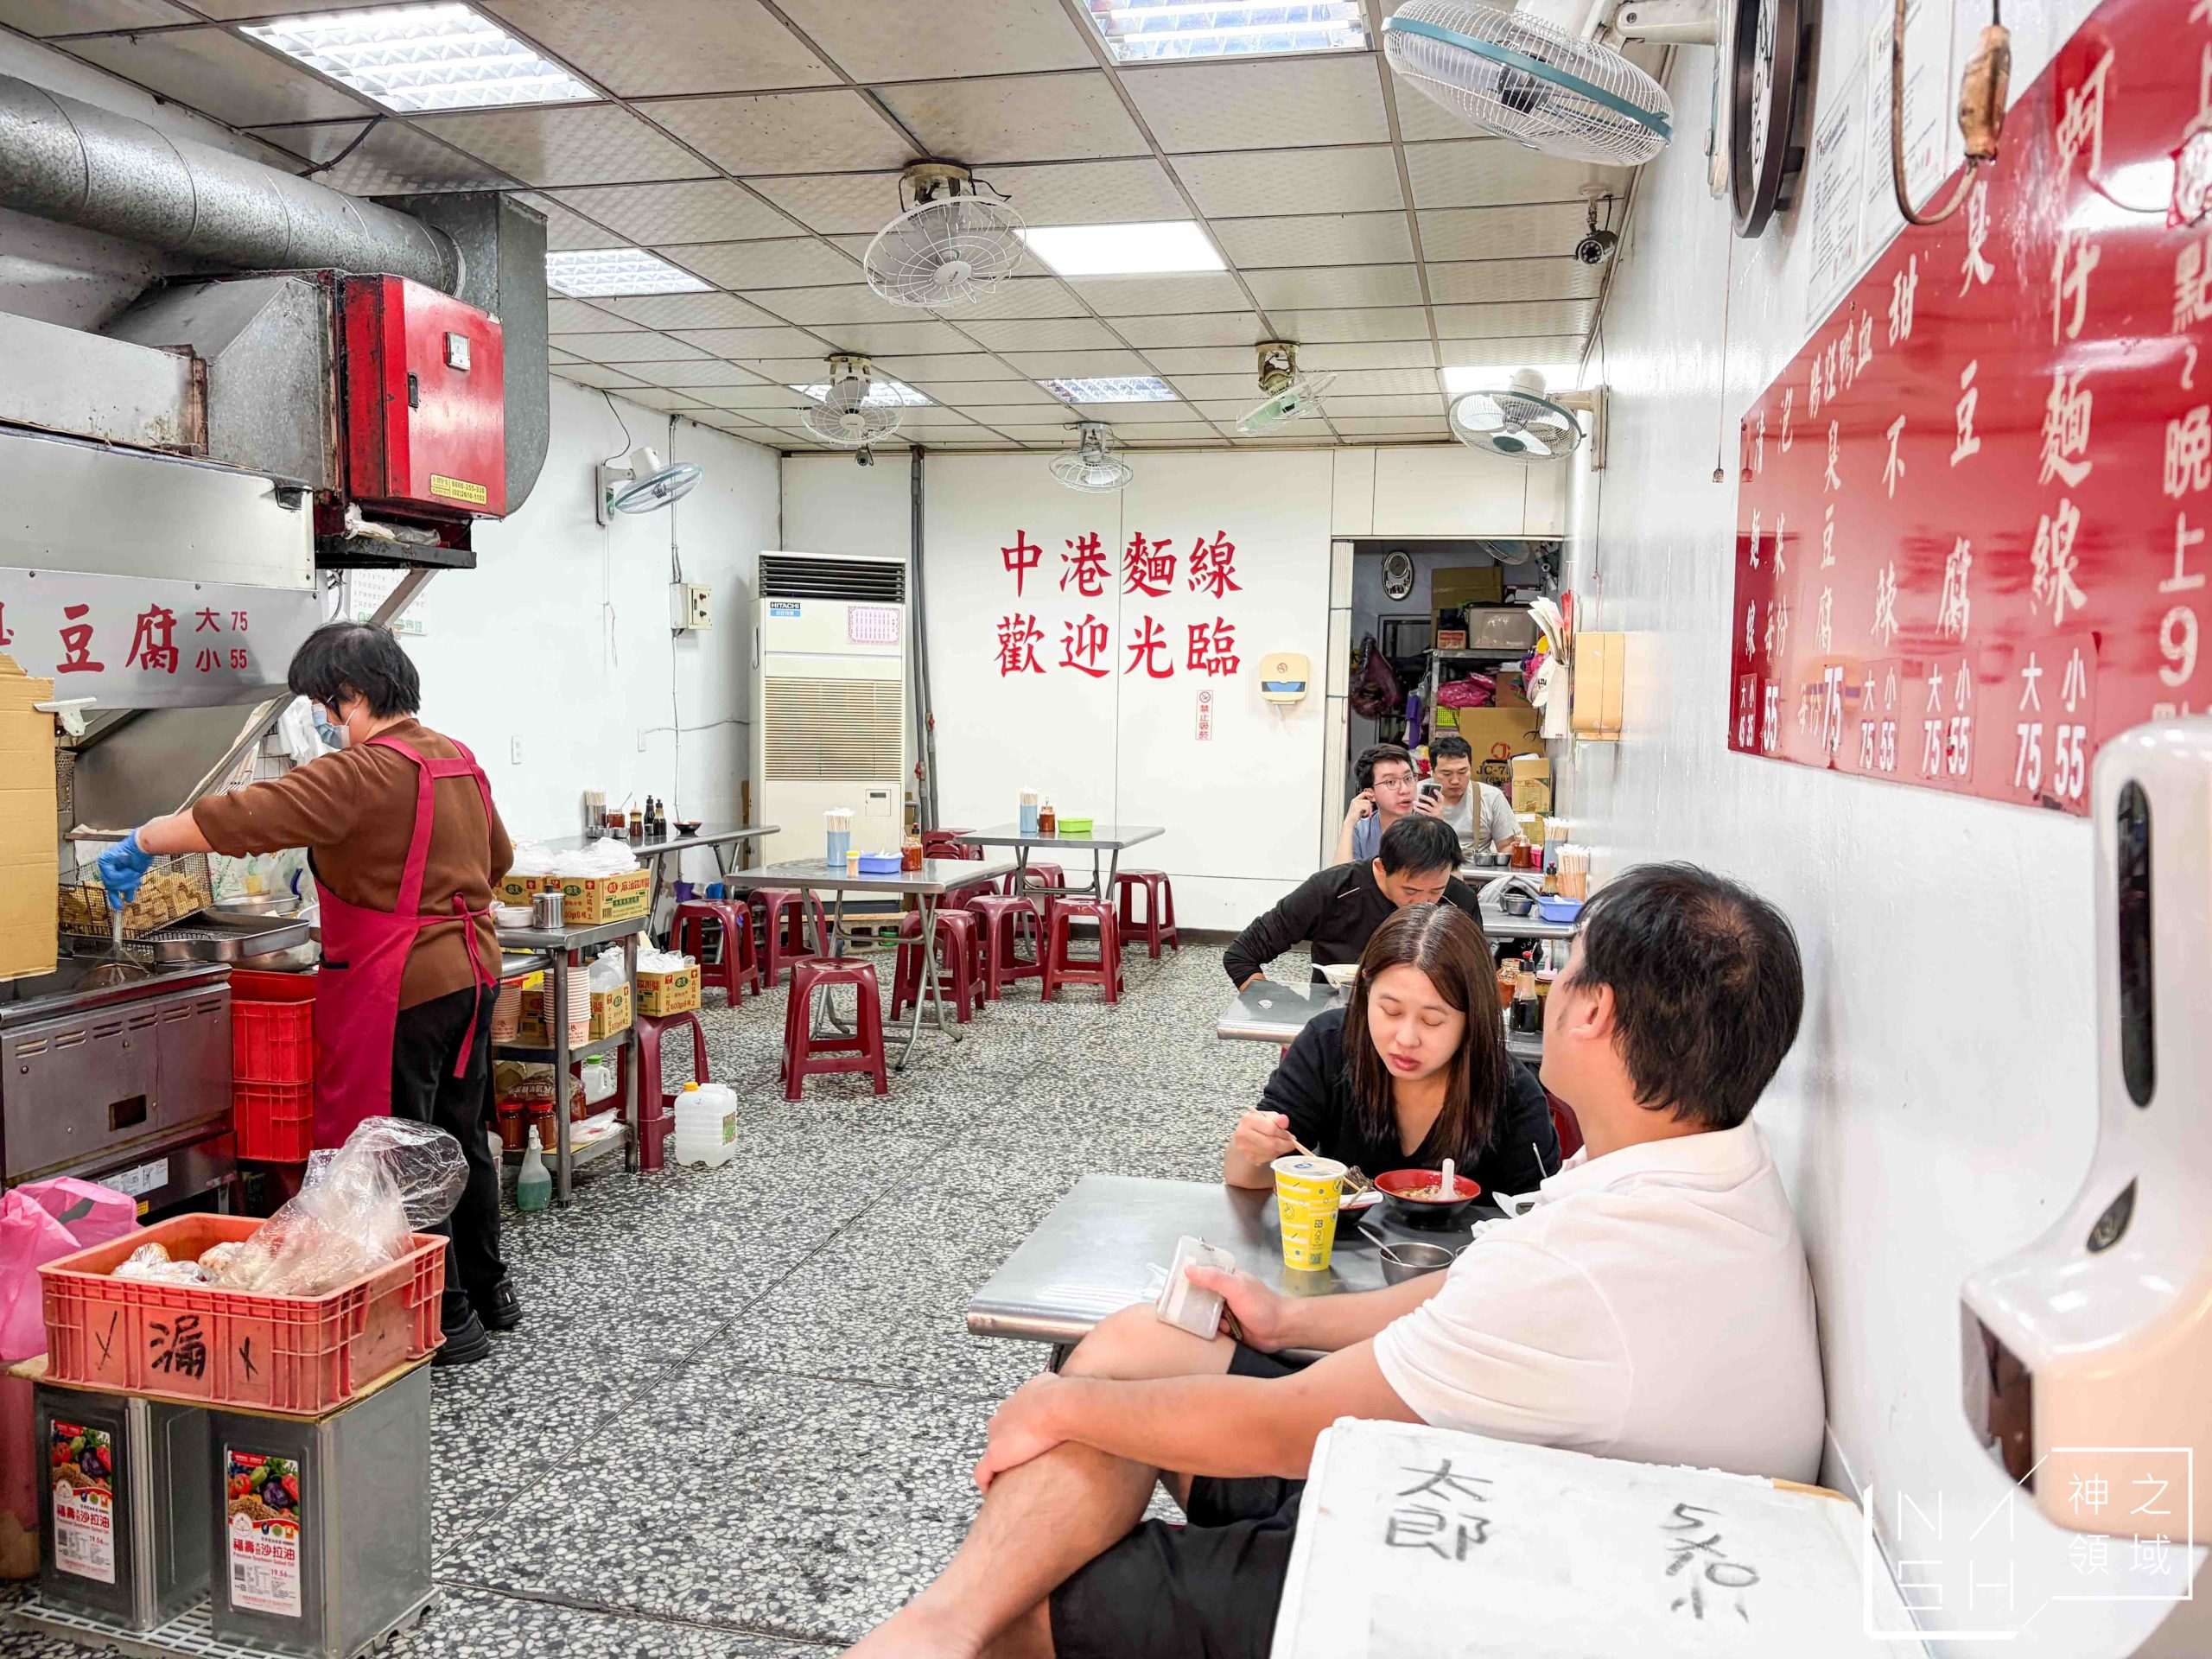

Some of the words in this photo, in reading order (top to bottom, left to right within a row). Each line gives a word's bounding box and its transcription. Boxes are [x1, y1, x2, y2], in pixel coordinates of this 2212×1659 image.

[1936, 179, 1995, 642] 臭豆腐
[1870, 253, 1919, 646] 甜不辣
[1000, 529, 1243, 600] 中港麵線
[1816, 419, 1841, 655] 臭豆腐
[0, 601, 179, 674] 豆腐
[195, 607, 220, 632] 大
[231, 611, 248, 632] 75
[993, 613, 1241, 679] 歡迎光臨
[195, 648, 221, 672] 小
[230, 649, 247, 669] 55
[1863, 670, 1875, 711] 大
[1885, 666, 1896, 711] 小
[1926, 664, 1942, 712] 大
[1955, 658, 1971, 712] 小
[2019, 652, 2043, 712] 大
[2062, 648, 2086, 712] 小
[1764, 685, 1779, 752] 55
[1822, 665, 1844, 752] 75
[1859, 722, 1875, 771] 75
[1879, 721, 1895, 772] 55
[1922, 720, 1942, 775] 75
[1948, 716, 1971, 775] 55
[2014, 723, 2044, 791] 75
[2054, 724, 2087, 798] 55
[149, 1314, 207, 1380] 漏
[1385, 1458, 1493, 1562] 太郎
